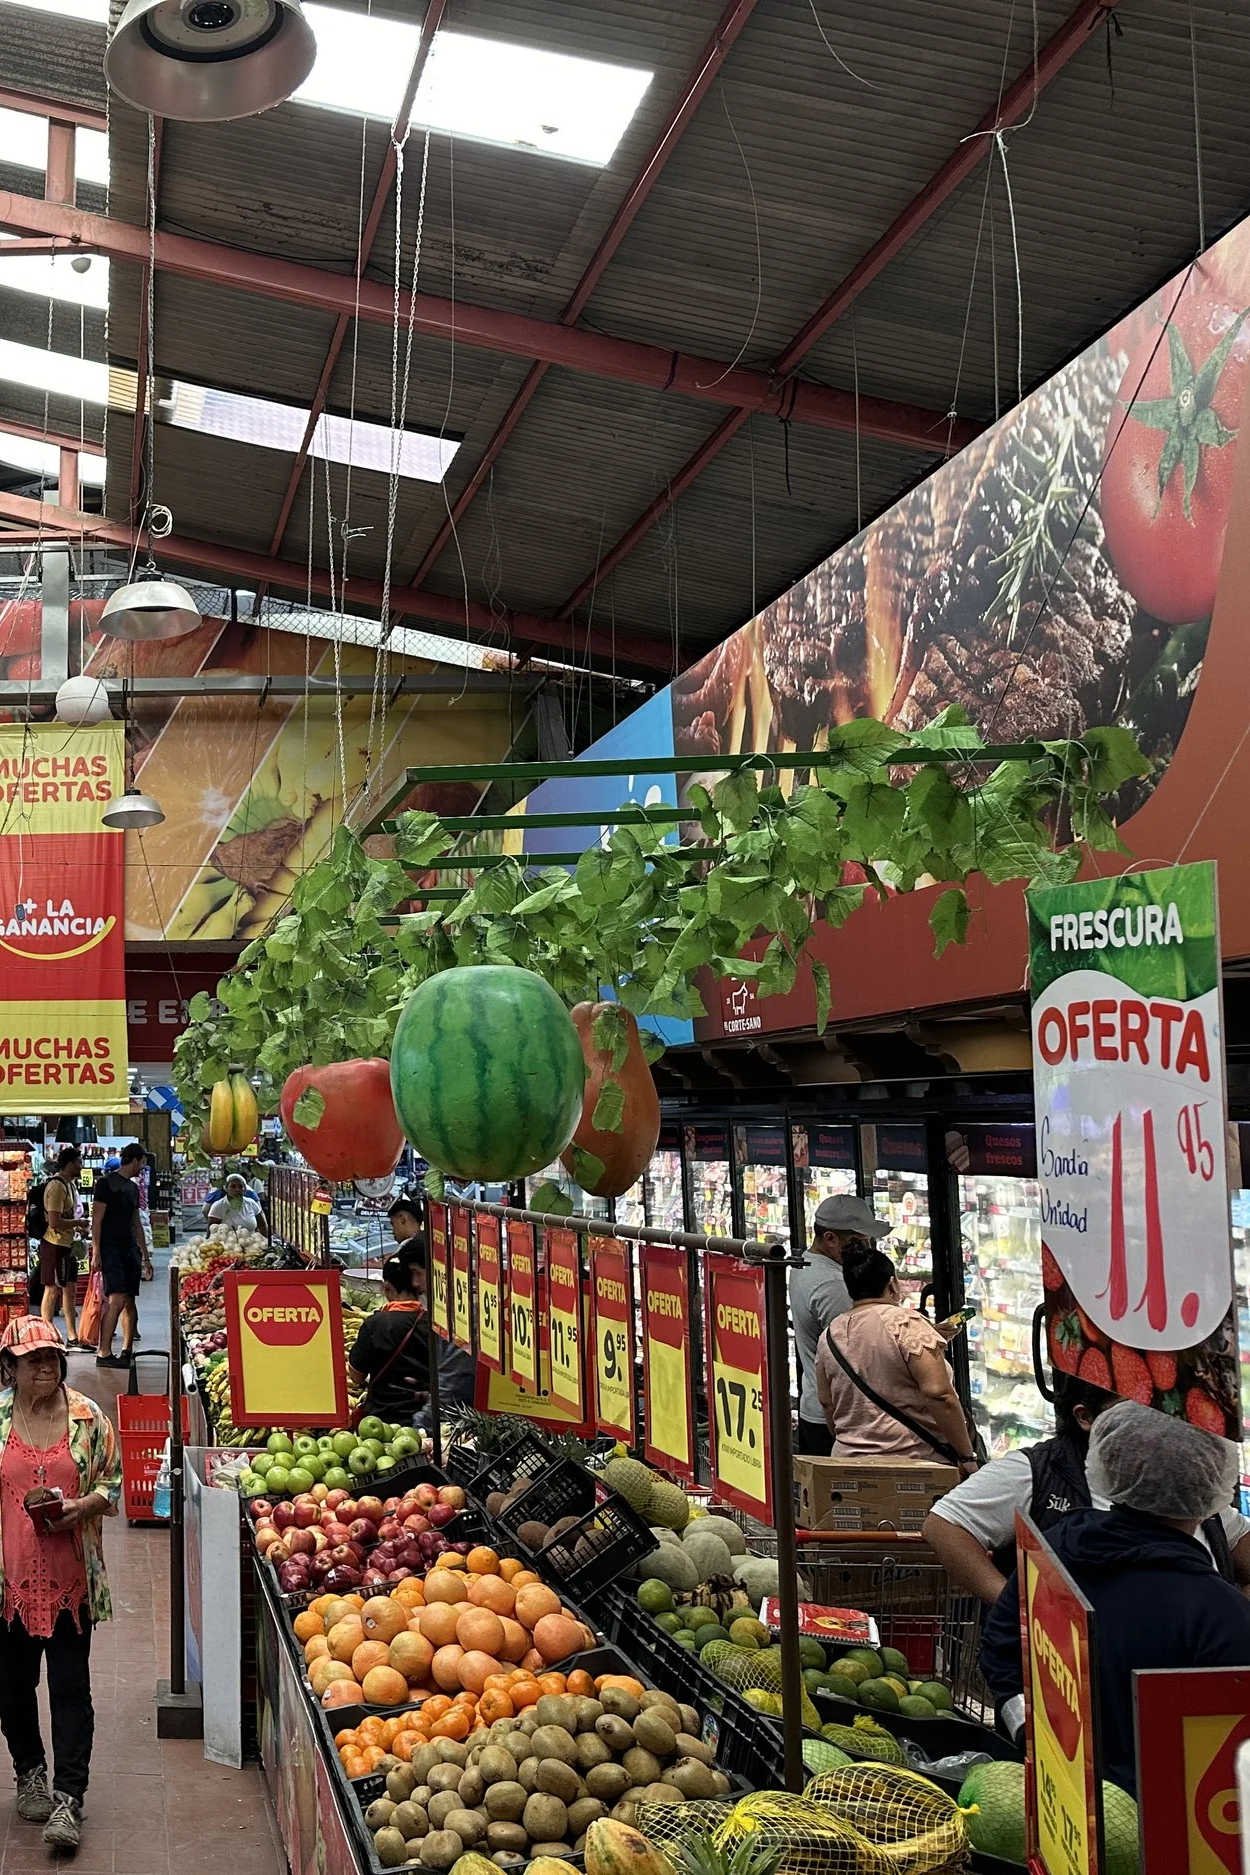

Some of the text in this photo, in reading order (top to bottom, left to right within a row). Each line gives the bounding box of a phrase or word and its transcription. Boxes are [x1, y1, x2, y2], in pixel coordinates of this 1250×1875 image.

[46, 899, 75, 917] LA
[1050, 903, 1183, 951] FRESCURA
[1038, 999, 1210, 1083] OFERTA
[984, 1133, 1022, 1148] Quesos
[984, 1151, 1023, 1166] frescos
[479, 1244, 497, 1264] OFERTA
[511, 1253, 531, 1274] OFERTA
[550, 1263, 575, 1288] OFERTA
[597, 1276, 626, 1304] OFERTA
[247, 1306, 321, 1325] OFERTA
[647, 1290, 682, 1319] OFERTA
[717, 1303, 760, 1339] OFERTA
[1034, 1618, 1080, 1722] OFERTA
